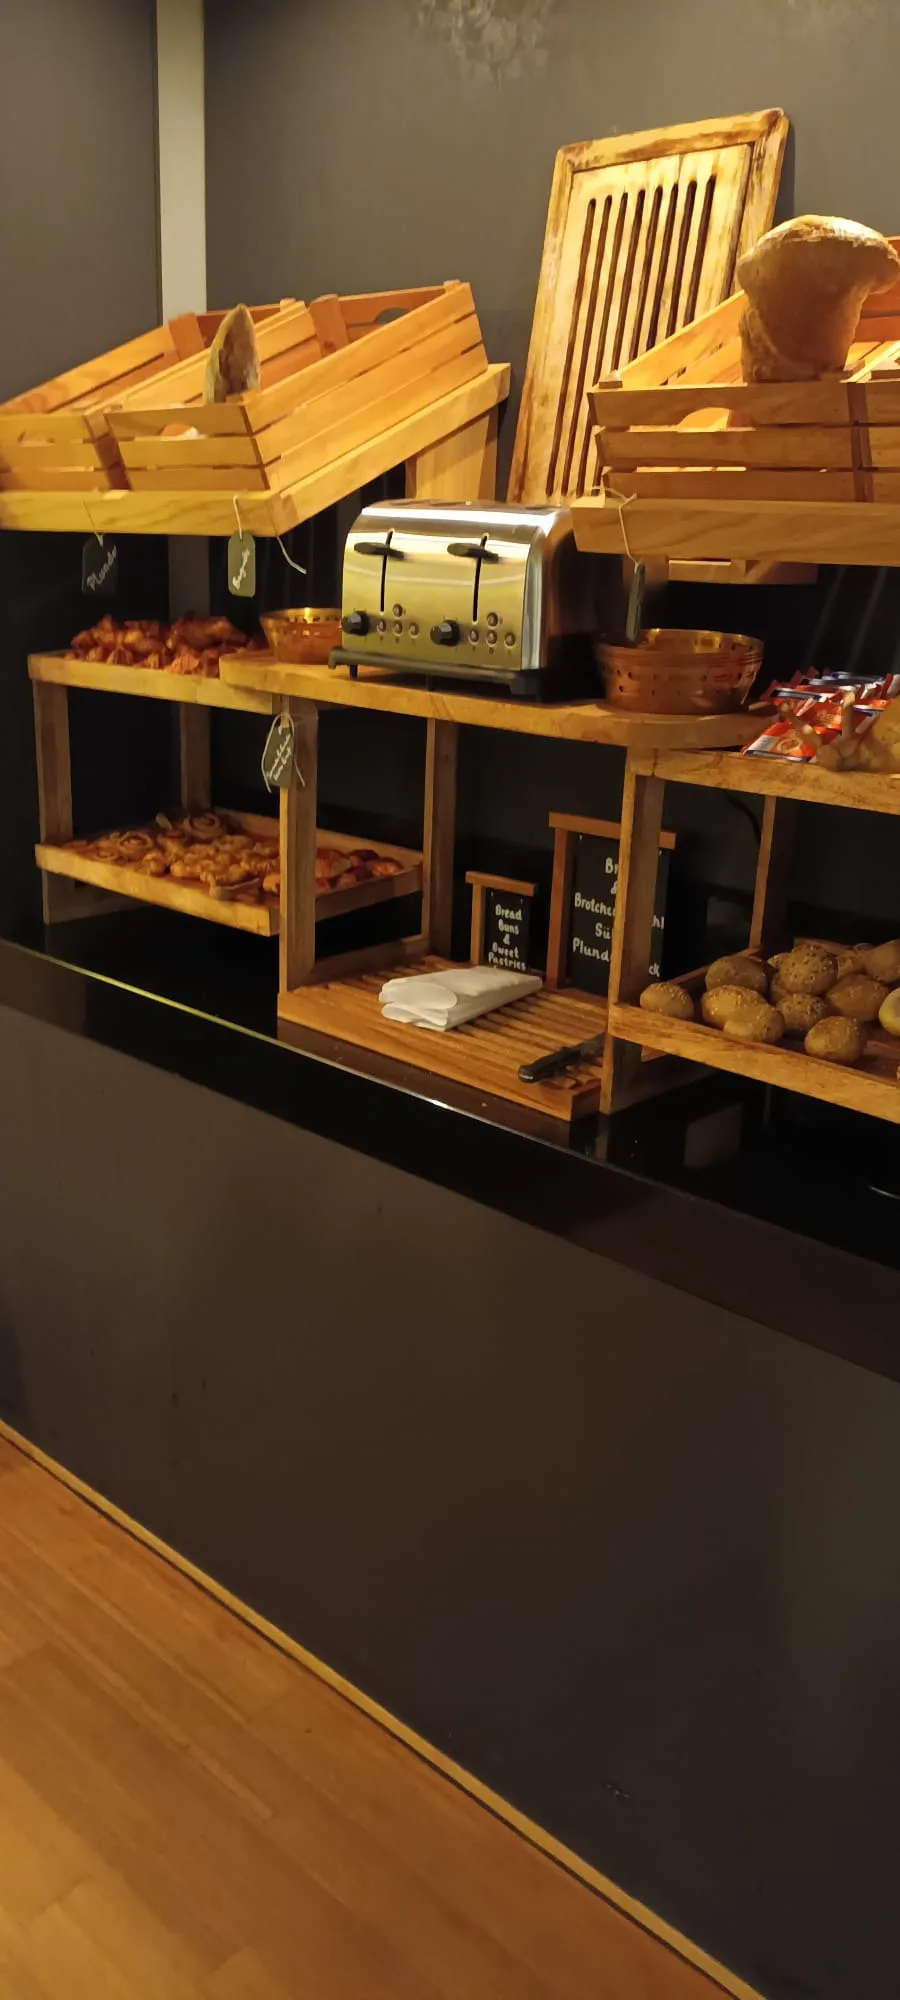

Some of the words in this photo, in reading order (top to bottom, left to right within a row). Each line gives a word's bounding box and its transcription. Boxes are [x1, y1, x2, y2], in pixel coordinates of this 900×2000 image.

[605, 857, 619, 874] Br
[495, 903, 522, 920] Bread
[498, 918, 520, 935] Buns
[503, 933, 511, 945] &
[492, 942, 519, 959] Sweet
[488, 951, 527, 971] Pastries
